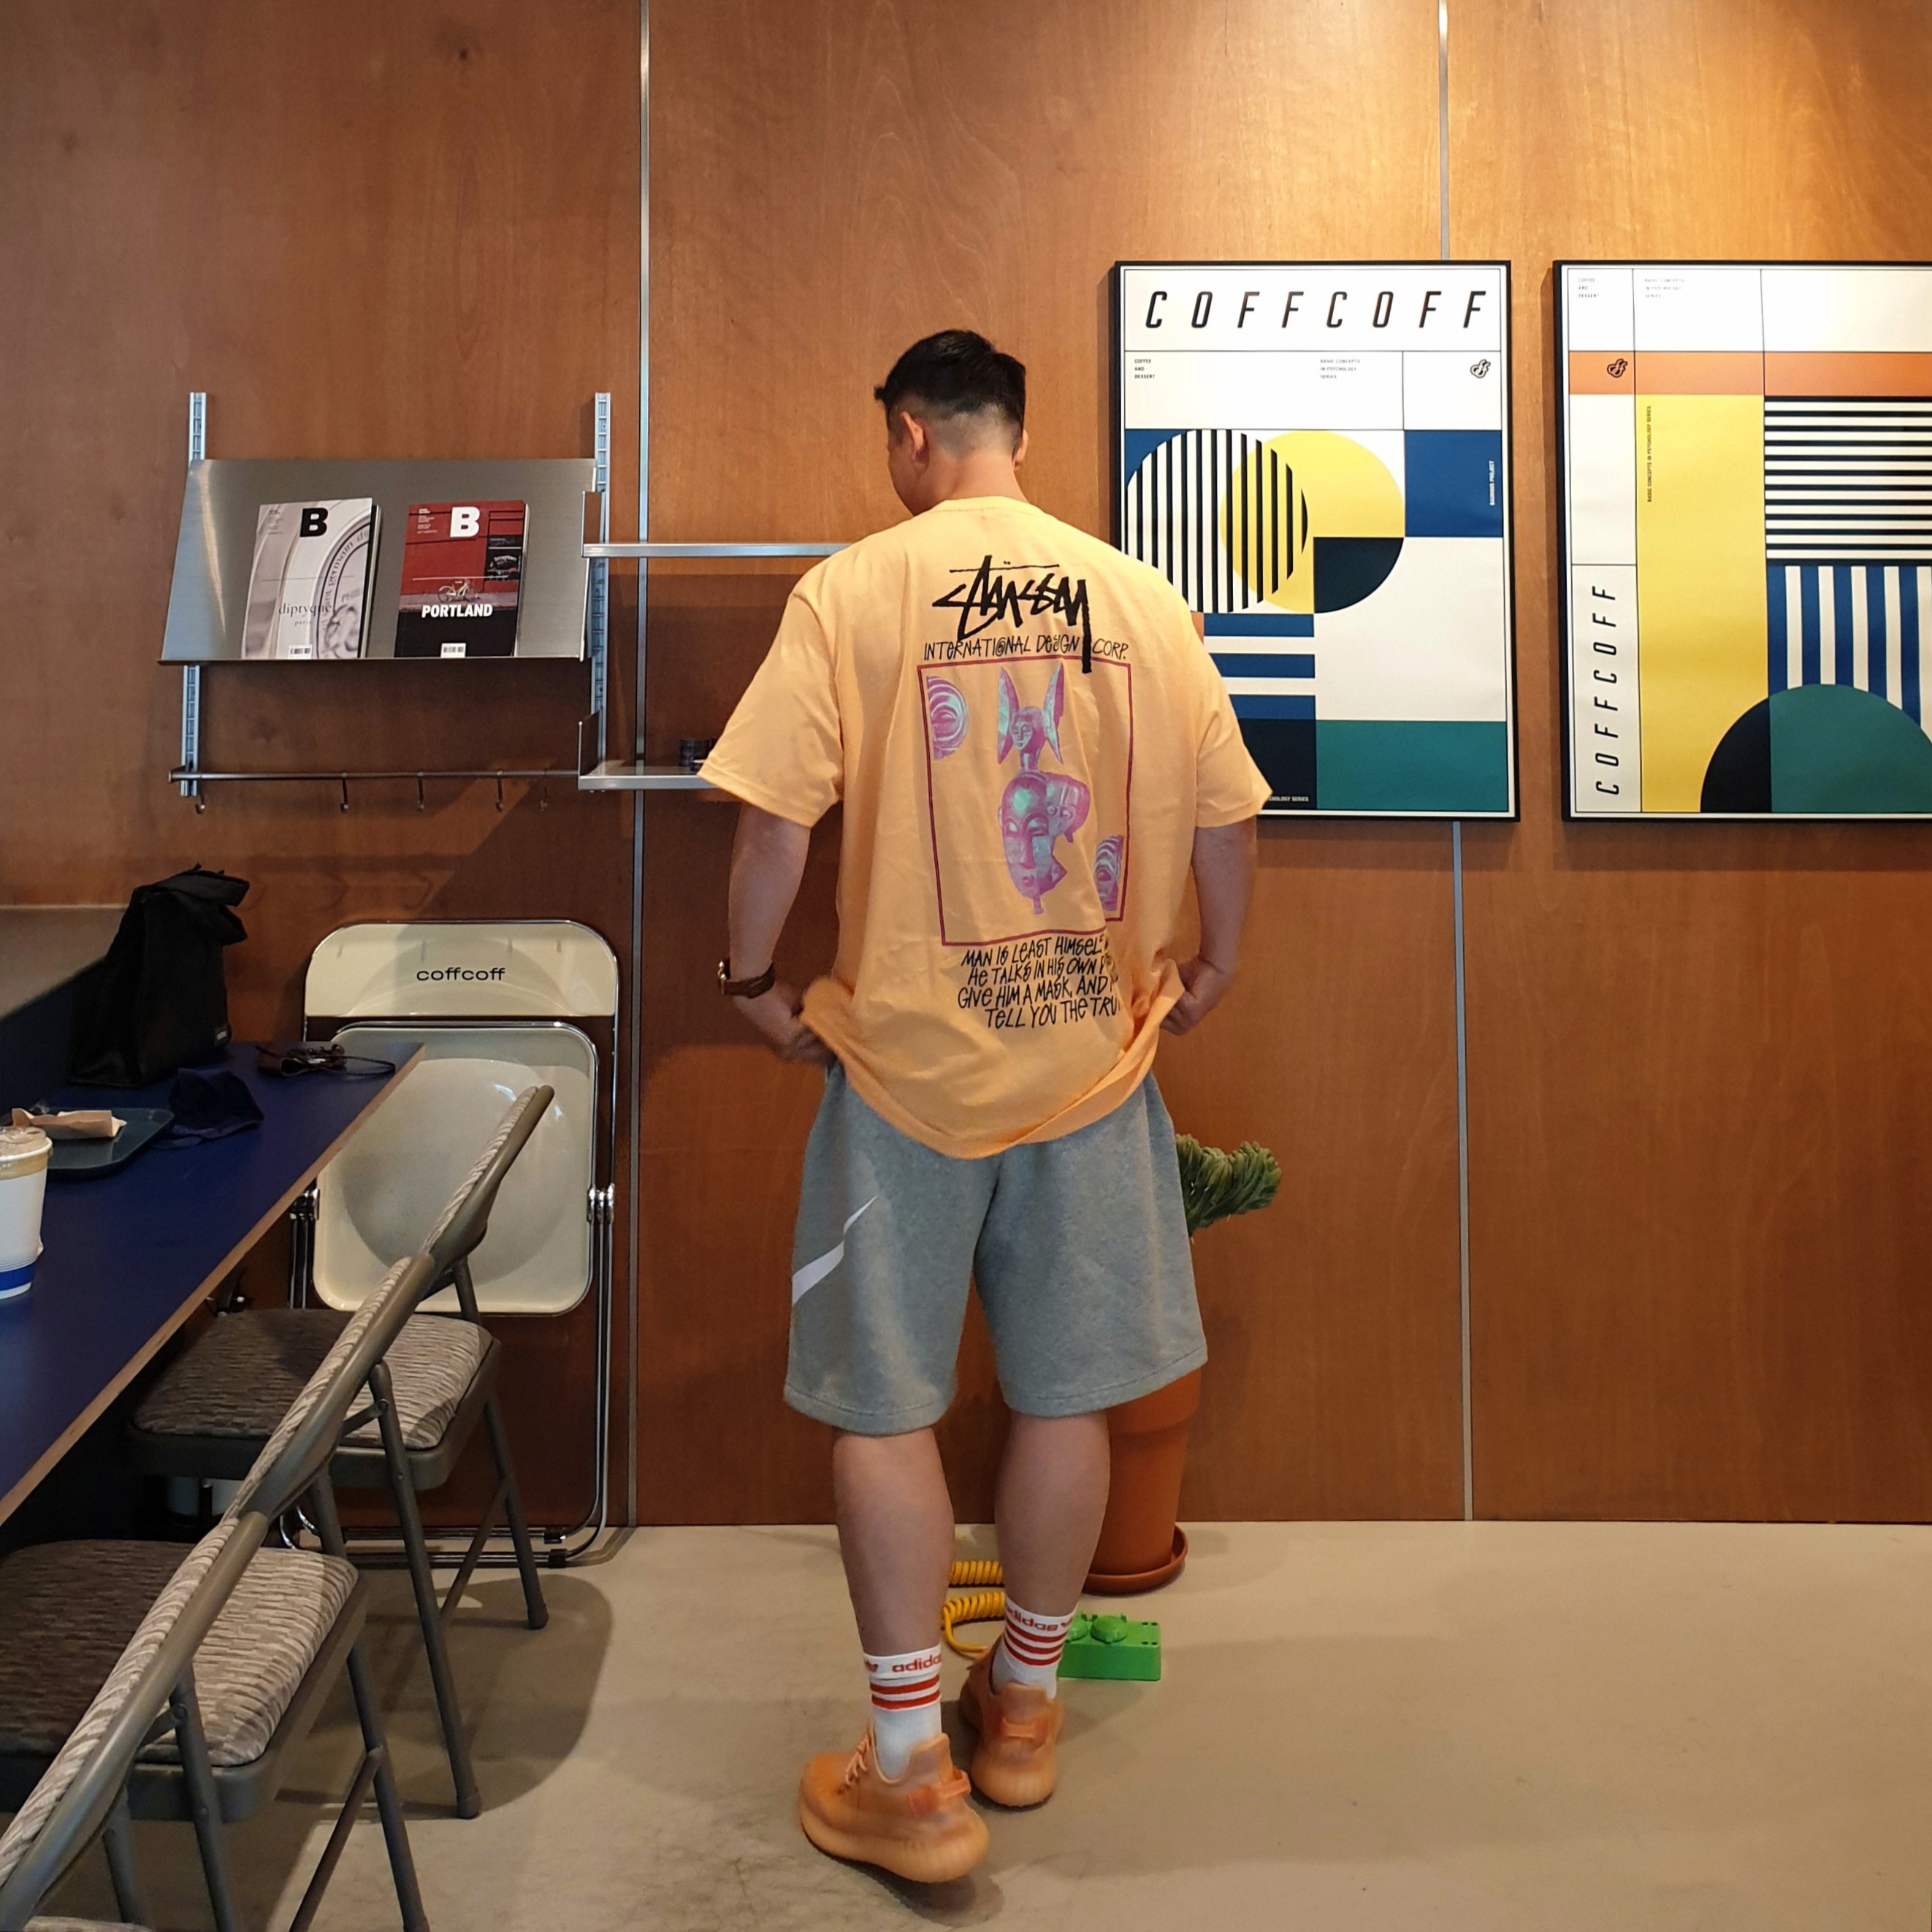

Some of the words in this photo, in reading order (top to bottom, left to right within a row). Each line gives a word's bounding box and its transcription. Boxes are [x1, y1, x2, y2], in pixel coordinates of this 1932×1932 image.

[1145, 290, 1487, 329] COFFCOFF
[299, 506, 329, 538] B
[449, 506, 481, 538] B
[421, 603, 494, 619] PORTLAND
[1591, 585, 1620, 795] COFFCOFF
[961, 949, 993, 967] MAN
[996, 945, 1009, 965] IS
[991, 963, 1031, 985] TALKS
[1034, 959, 1045, 980] IN
[1047, 956, 1064, 977] HIS
[1066, 958, 1098, 975] OWN
[416, 966, 506, 982] coffcoff
[958, 986, 993, 1009] GIVE
[996, 983, 1020, 1008] HIM
[1023, 983, 1033, 1007] A
[1076, 975, 1109, 996] AND
[984, 1007, 1026, 1029] TELL
[1030, 1004, 1058, 1028] YOU
[1060, 997, 1088, 1023] THE
[1089, 995, 1122, 1017] TRU
[892, 1653, 942, 1673] adida
